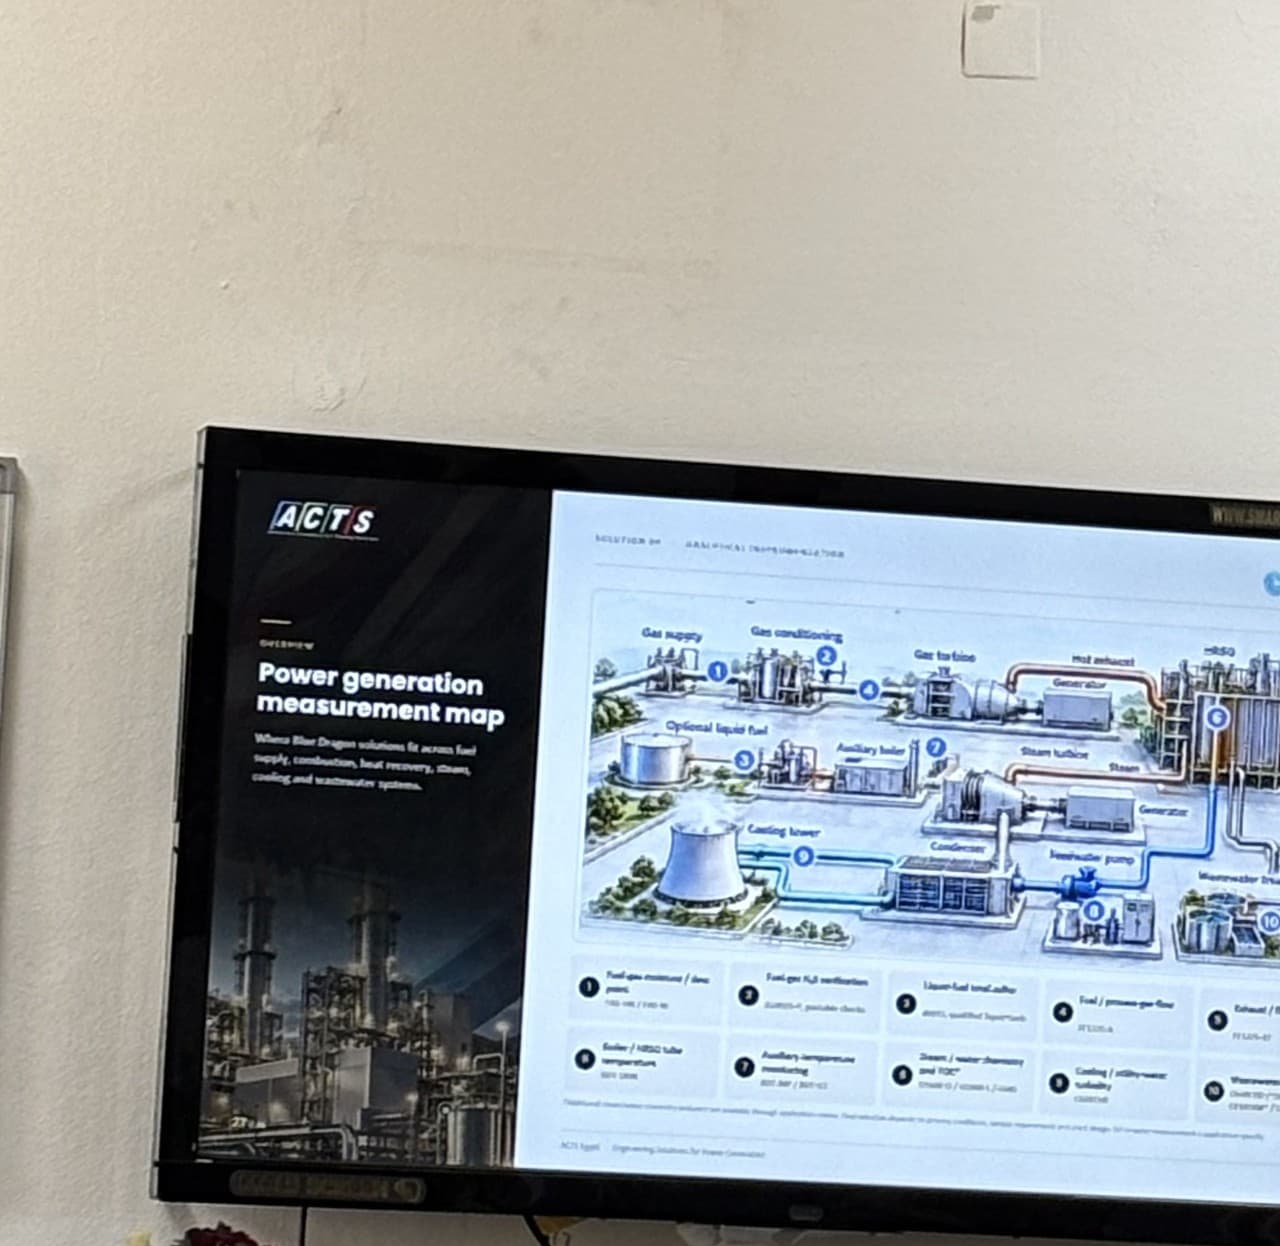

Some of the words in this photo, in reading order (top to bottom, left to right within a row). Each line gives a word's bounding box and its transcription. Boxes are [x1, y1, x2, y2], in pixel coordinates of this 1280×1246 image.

[272, 502, 377, 535] ACTS
[641, 626, 662, 639] Gas
[665, 628, 703, 643] supply
[750, 625, 773, 638] Gas
[774, 627, 843, 644] conditioning
[914, 649, 935, 661] Gas
[258, 662, 338, 686] Power
[343, 672, 484, 696] generation
[1052, 678, 1107, 690] Generator
[257, 694, 441, 722] measurement
[445, 706, 505, 732] map
[665, 720, 713, 734] Optional
[716, 722, 745, 737] liquid
[748, 724, 769, 736] fuel
[318, 735, 356, 750] Dragon
[358, 739, 405, 752] solutions
[407, 741, 419, 753] fit
[421, 743, 454, 755] across
[456, 745, 477, 756] fuel
[360, 758, 384, 769] heat
[292, 774, 313, 785] and
[1138, 804, 1189, 817] Generator
